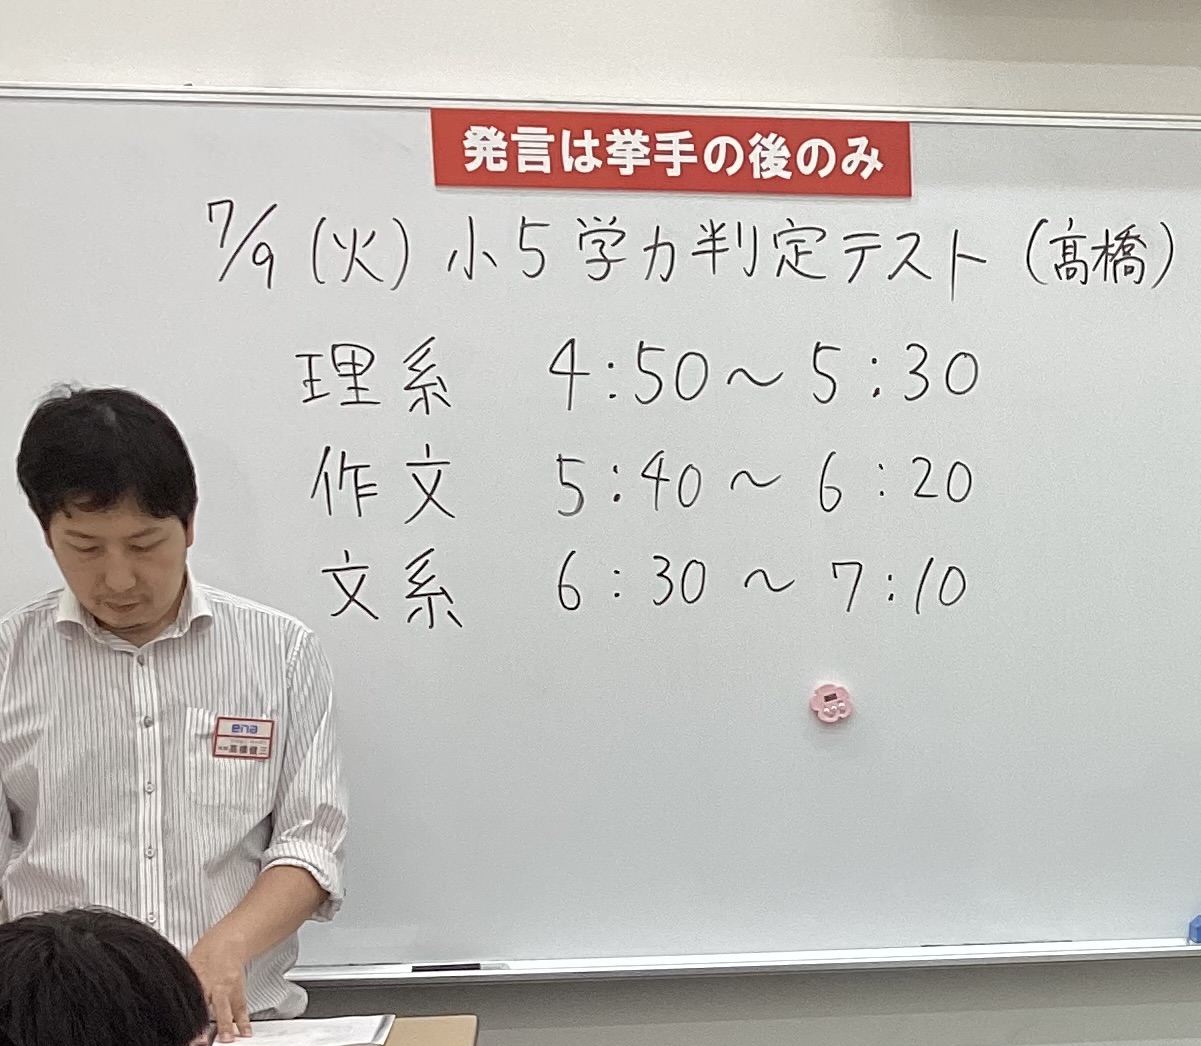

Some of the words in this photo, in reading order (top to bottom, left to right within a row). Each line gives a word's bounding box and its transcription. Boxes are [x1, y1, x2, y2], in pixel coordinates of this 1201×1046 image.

[463, 125, 884, 180] 発言は挙手の後のみ
[294, 335, 452, 416] 理系
[310, 442, 456, 525] 作文
[321, 547, 463, 630] 文系
